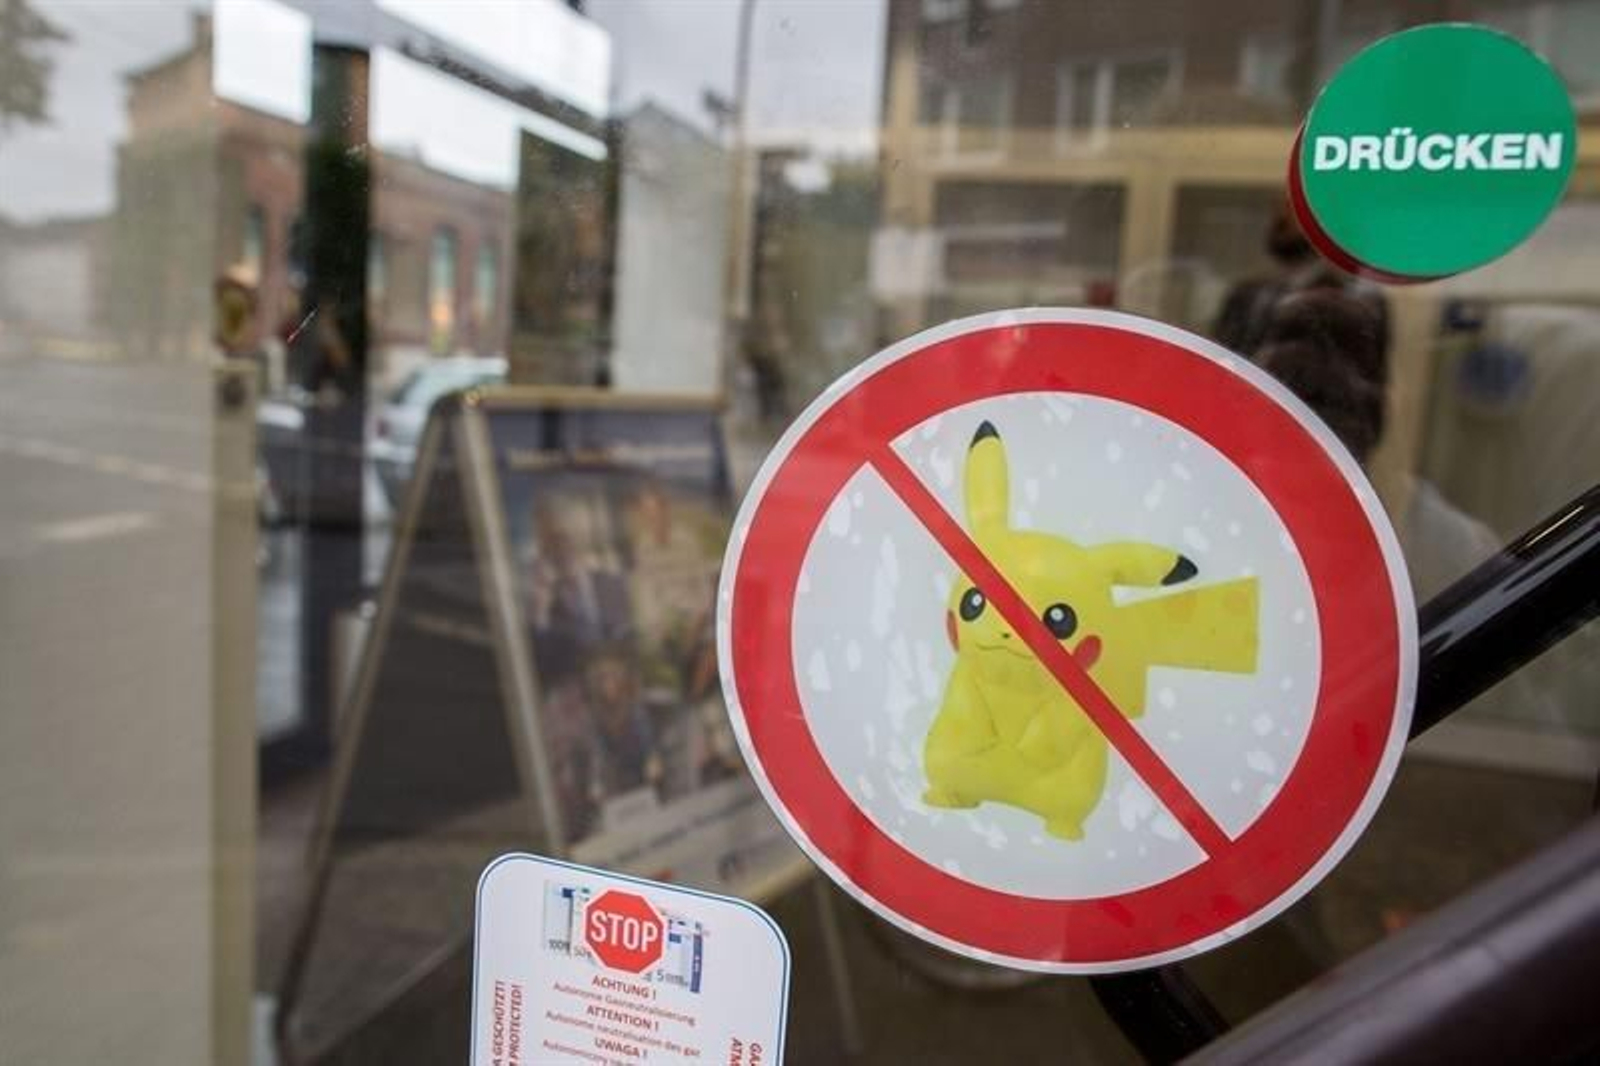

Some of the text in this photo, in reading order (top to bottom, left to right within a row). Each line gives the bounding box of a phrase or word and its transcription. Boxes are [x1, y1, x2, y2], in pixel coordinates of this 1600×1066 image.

[1313, 126, 1563, 171] DRÜCKEN
[590, 909, 658, 953] STOP
[592, 975, 649, 999] ACHTUNG
[509, 984, 523, 1060] PROTECTED!
[586, 1005, 650, 1030] ATTENTION
[594, 1038, 640, 1058] UWAGA
